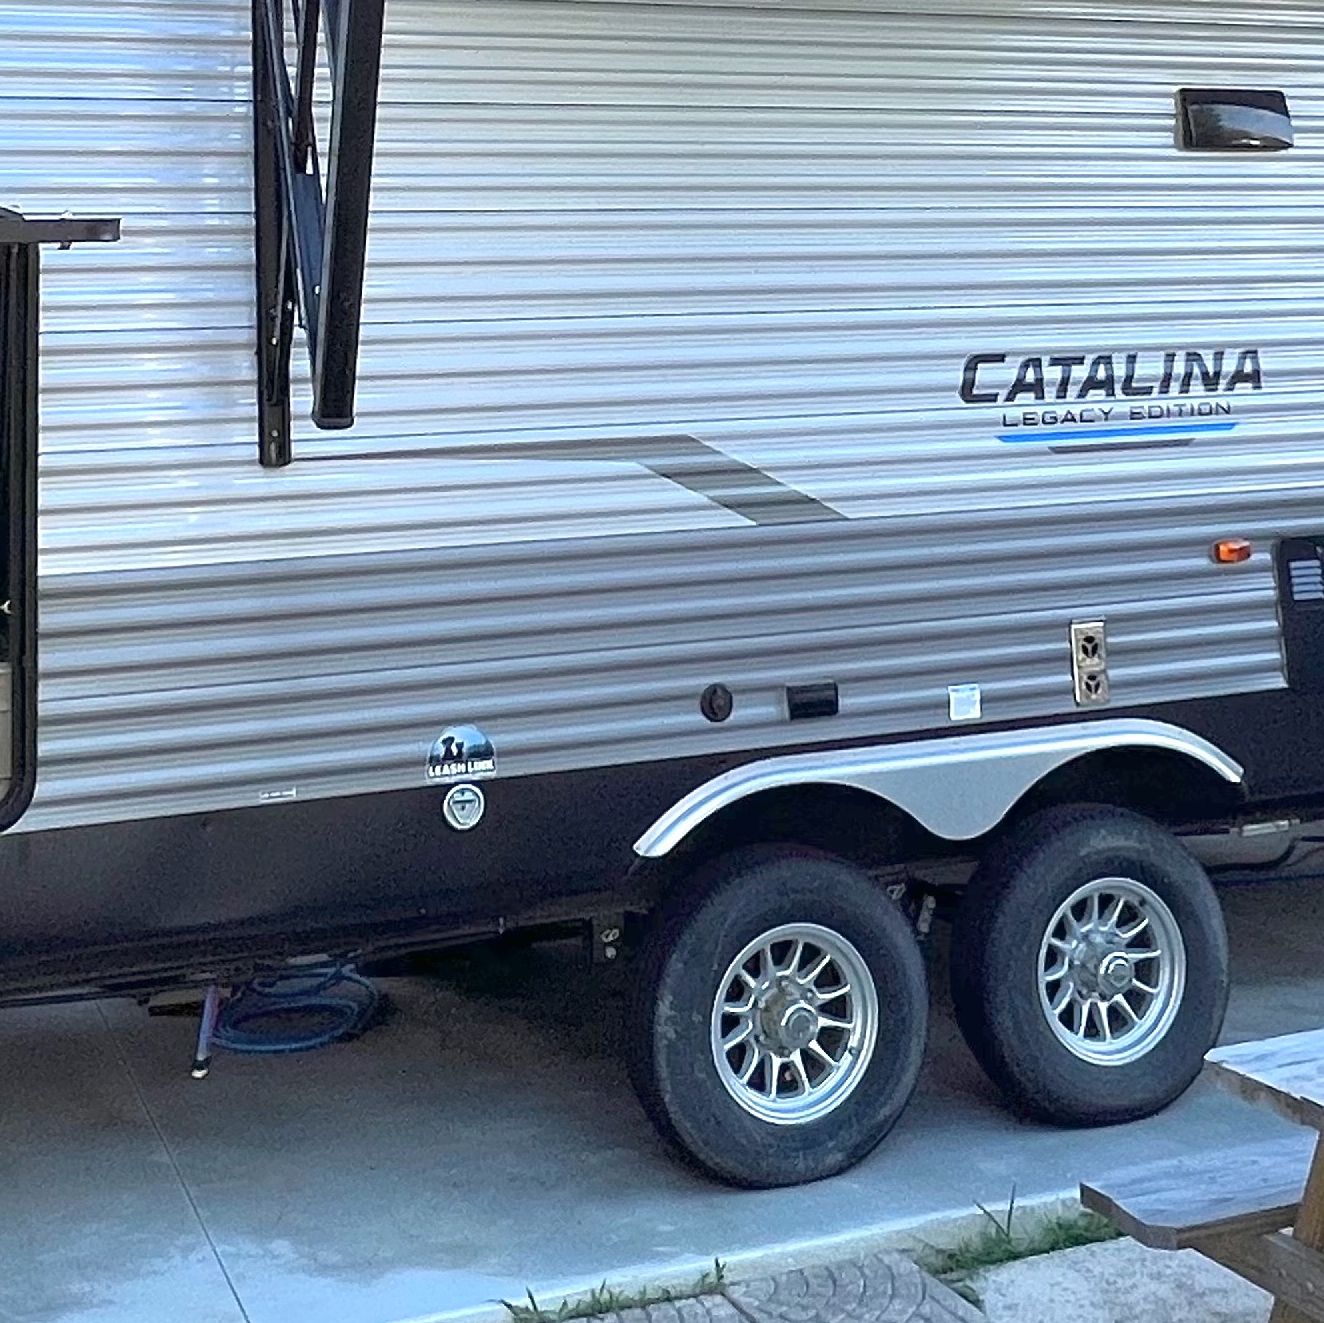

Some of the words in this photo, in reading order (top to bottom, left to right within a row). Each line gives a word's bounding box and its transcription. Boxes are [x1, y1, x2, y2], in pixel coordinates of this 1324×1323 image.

[959, 349, 1263, 403] CATALINA
[1002, 407, 1114, 427] LEGACY
[1129, 400, 1232, 420] EDITION
[429, 762, 466, 777] LEASH
